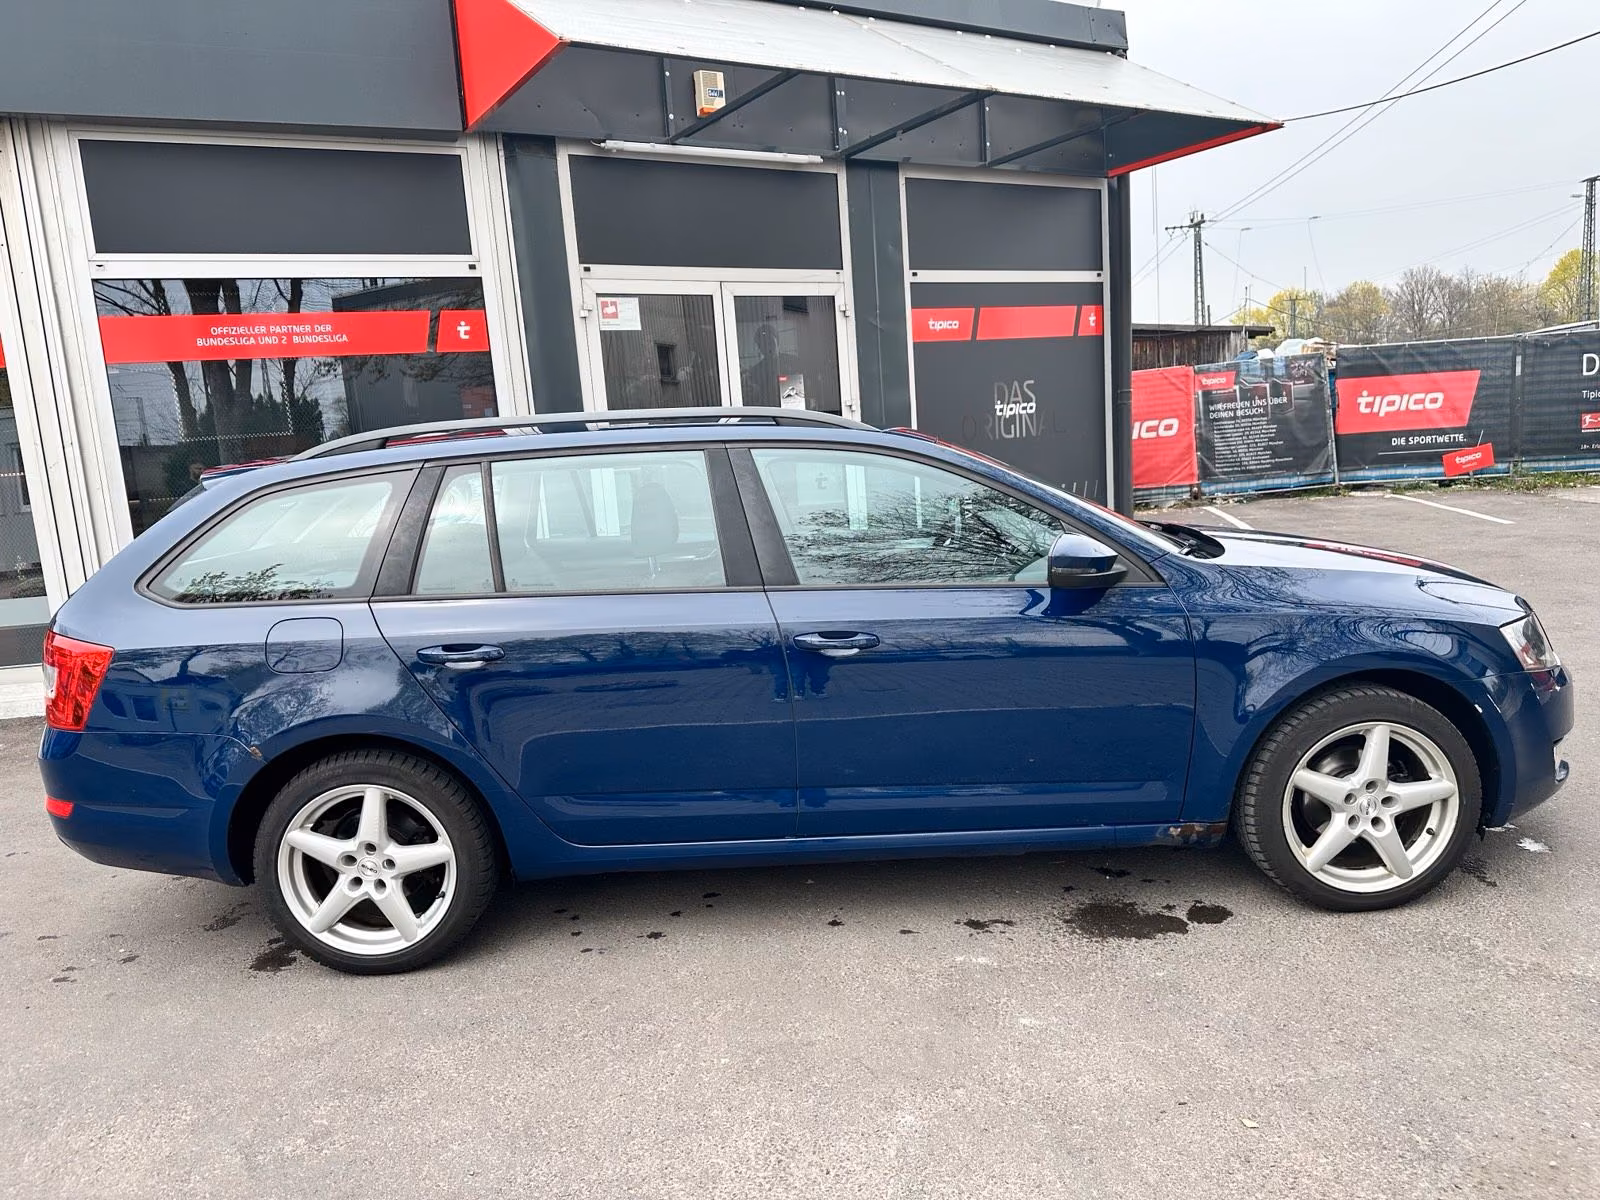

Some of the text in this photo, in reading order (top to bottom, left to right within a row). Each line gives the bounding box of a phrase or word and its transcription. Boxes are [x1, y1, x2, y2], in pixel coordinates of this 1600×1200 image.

[210, 324, 333, 335] OFFIZIELLER PARTNER DER
[928, 318, 960, 331] tipico
[196, 333, 348, 347] BUNDESLIGA UND 2 BUNDESLIGA
[994, 379, 1036, 405] DAS
[994, 400, 1036, 418] tipico
[1223, 400, 1250, 410] FREUEN
[1252, 398, 1267, 406] UNS
[1357, 390, 1444, 417] tipico
[1209, 410, 1234, 419] DEINEN
[1392, 434, 1467, 446] DIE SPORTWETTE.
[1455, 452, 1482, 464] tipico
